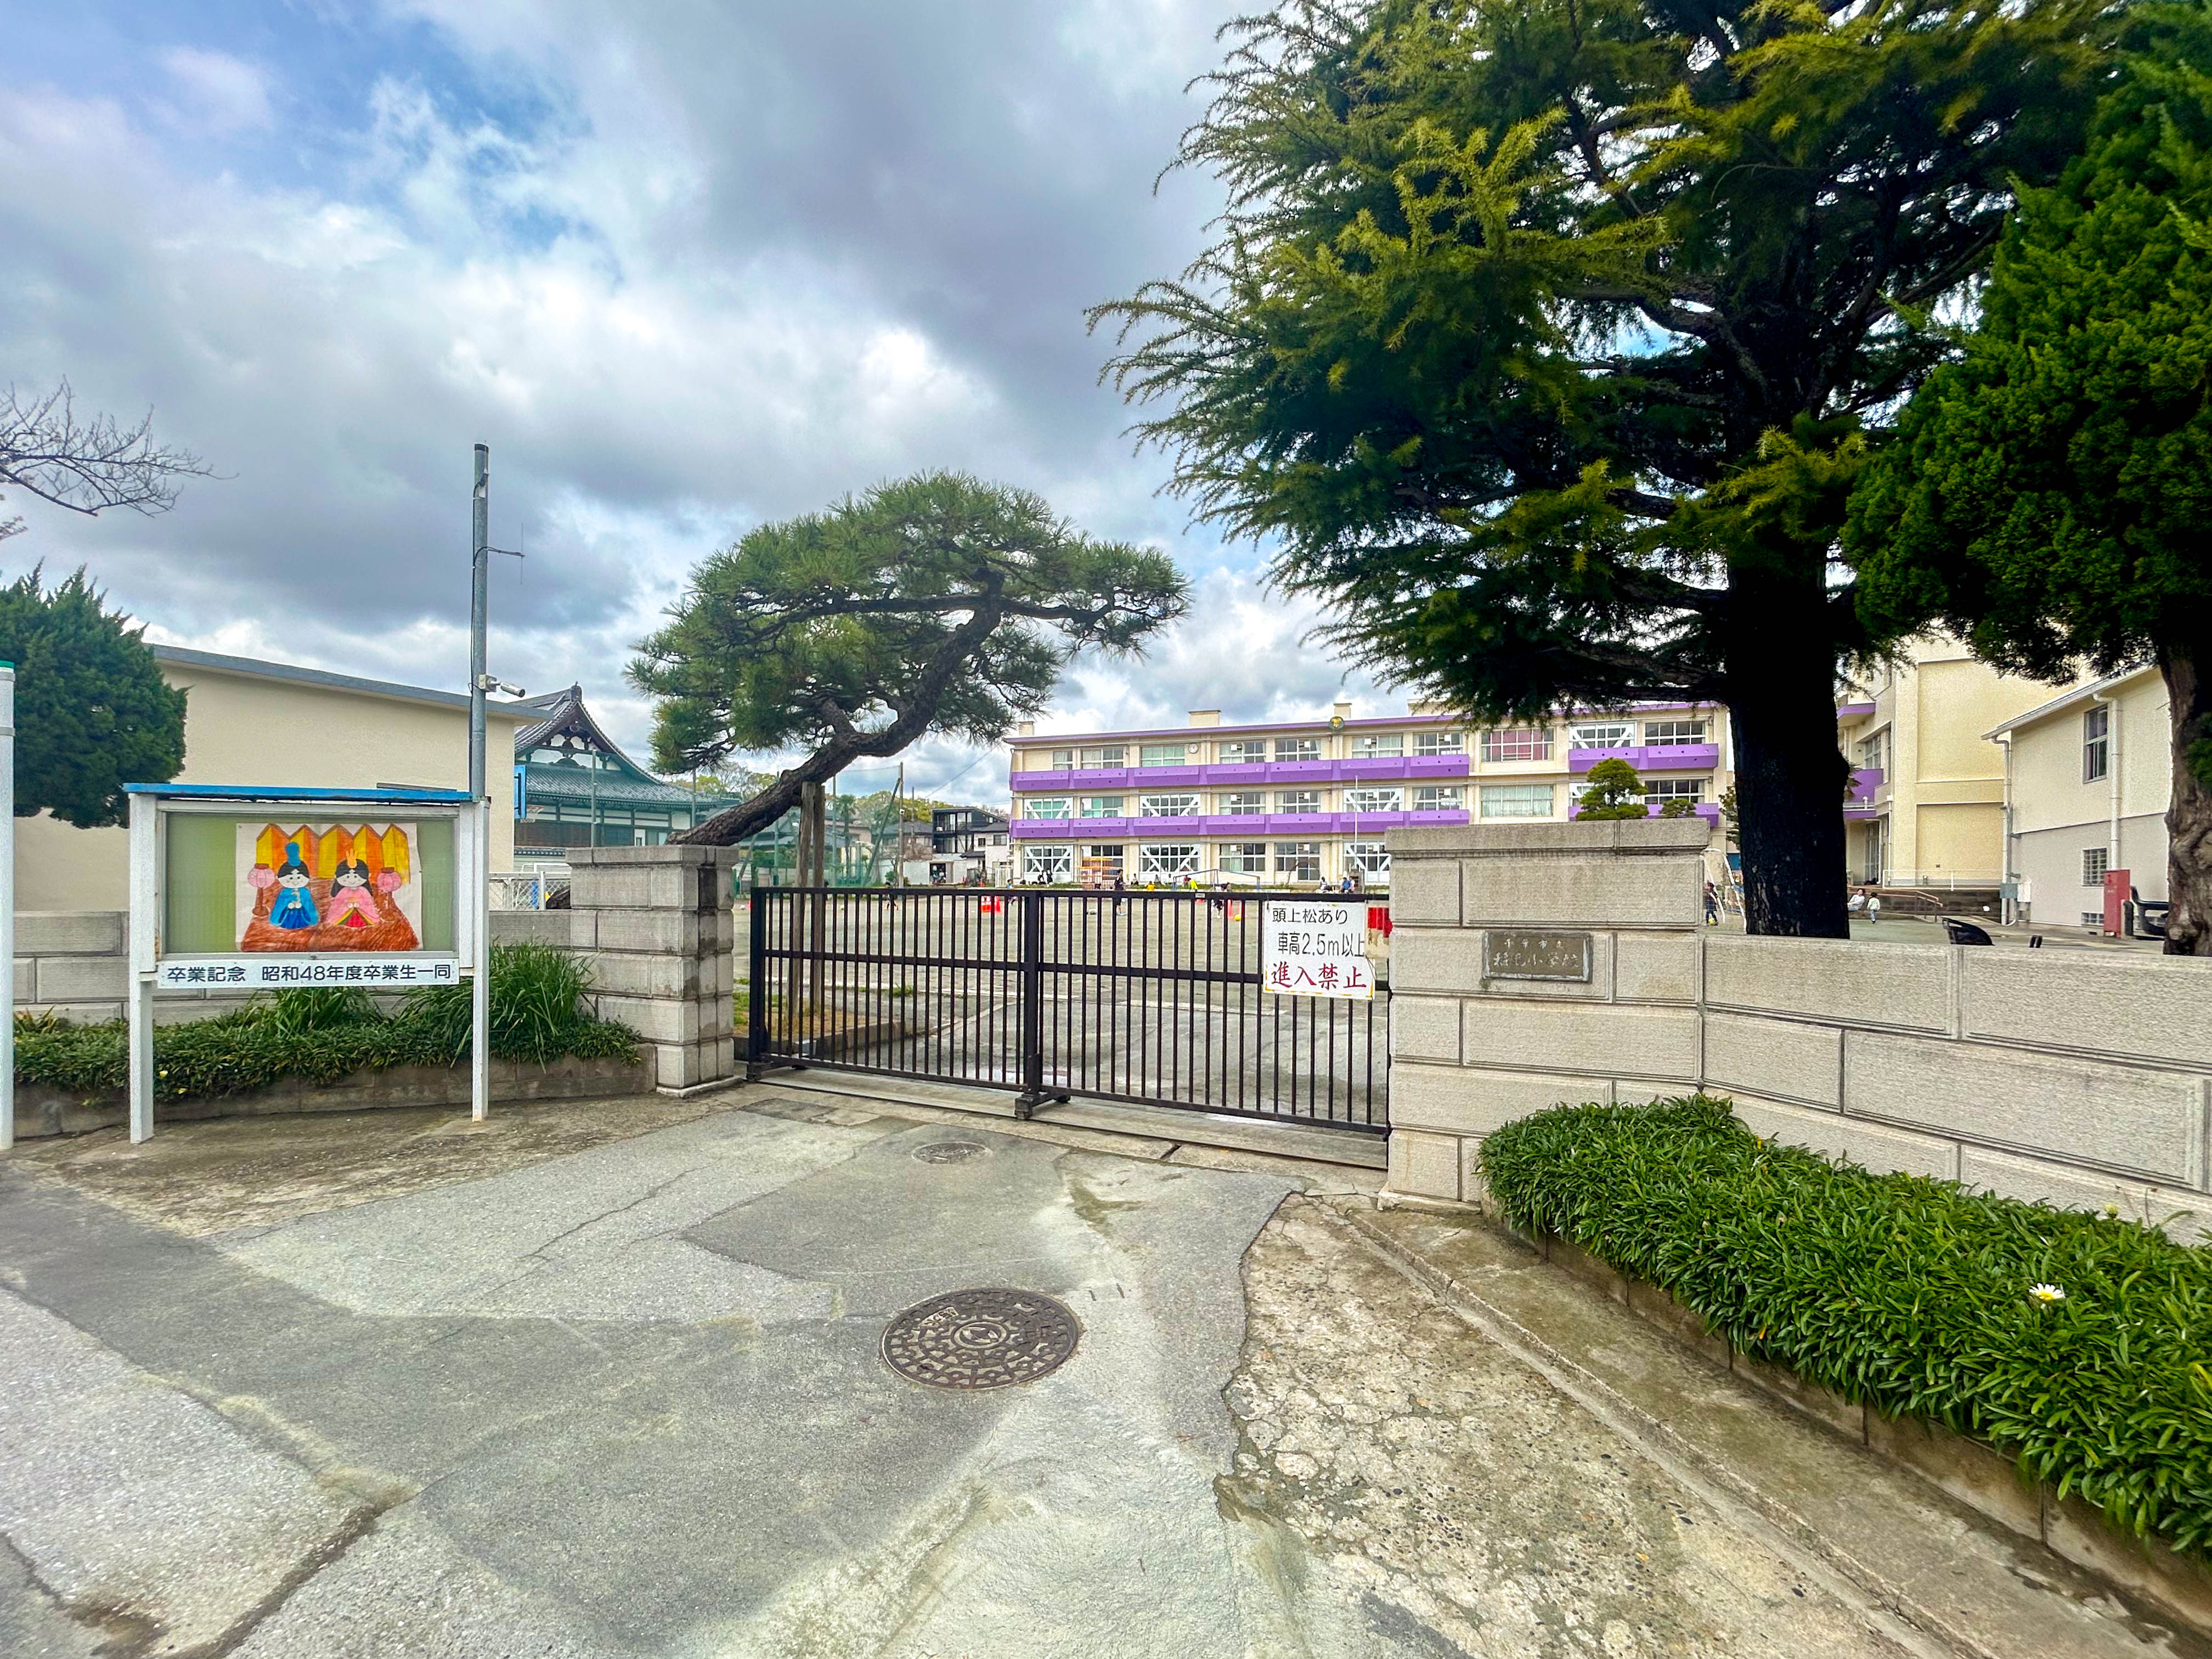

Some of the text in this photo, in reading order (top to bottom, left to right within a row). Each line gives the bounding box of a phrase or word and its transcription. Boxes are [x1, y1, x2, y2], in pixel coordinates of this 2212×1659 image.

[1272, 907, 1348, 924] 頭上松あり
[1278, 931, 1365, 957] 車高2.5m以上
[167, 964, 451, 983] 卒業記念 昭和48年度卒業生一同
[1271, 961, 1367, 991] 進入禁止
